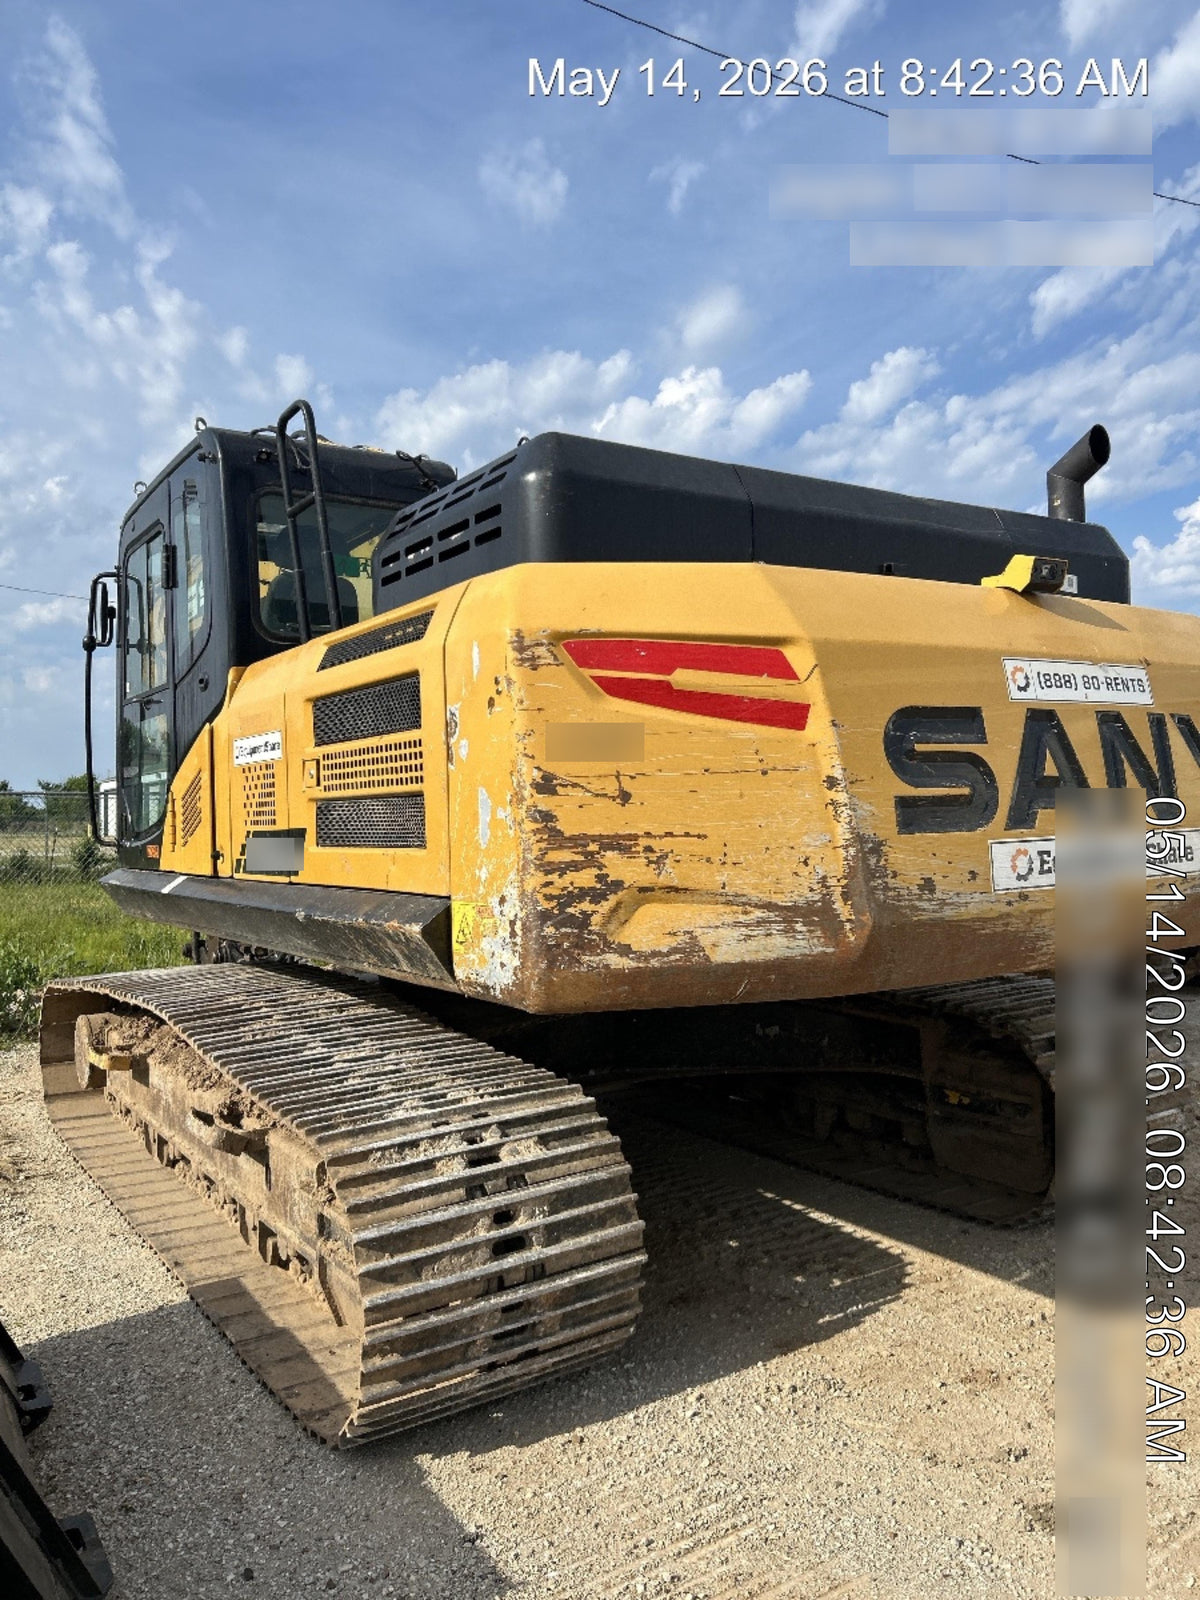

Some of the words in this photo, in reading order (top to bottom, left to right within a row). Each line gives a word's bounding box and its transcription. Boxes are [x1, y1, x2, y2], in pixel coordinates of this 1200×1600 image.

[1037, 672, 1078, 691] (888)
[1082, 675, 1146, 693] 80-RENTS
[883, 705, 1200, 835] SAN
